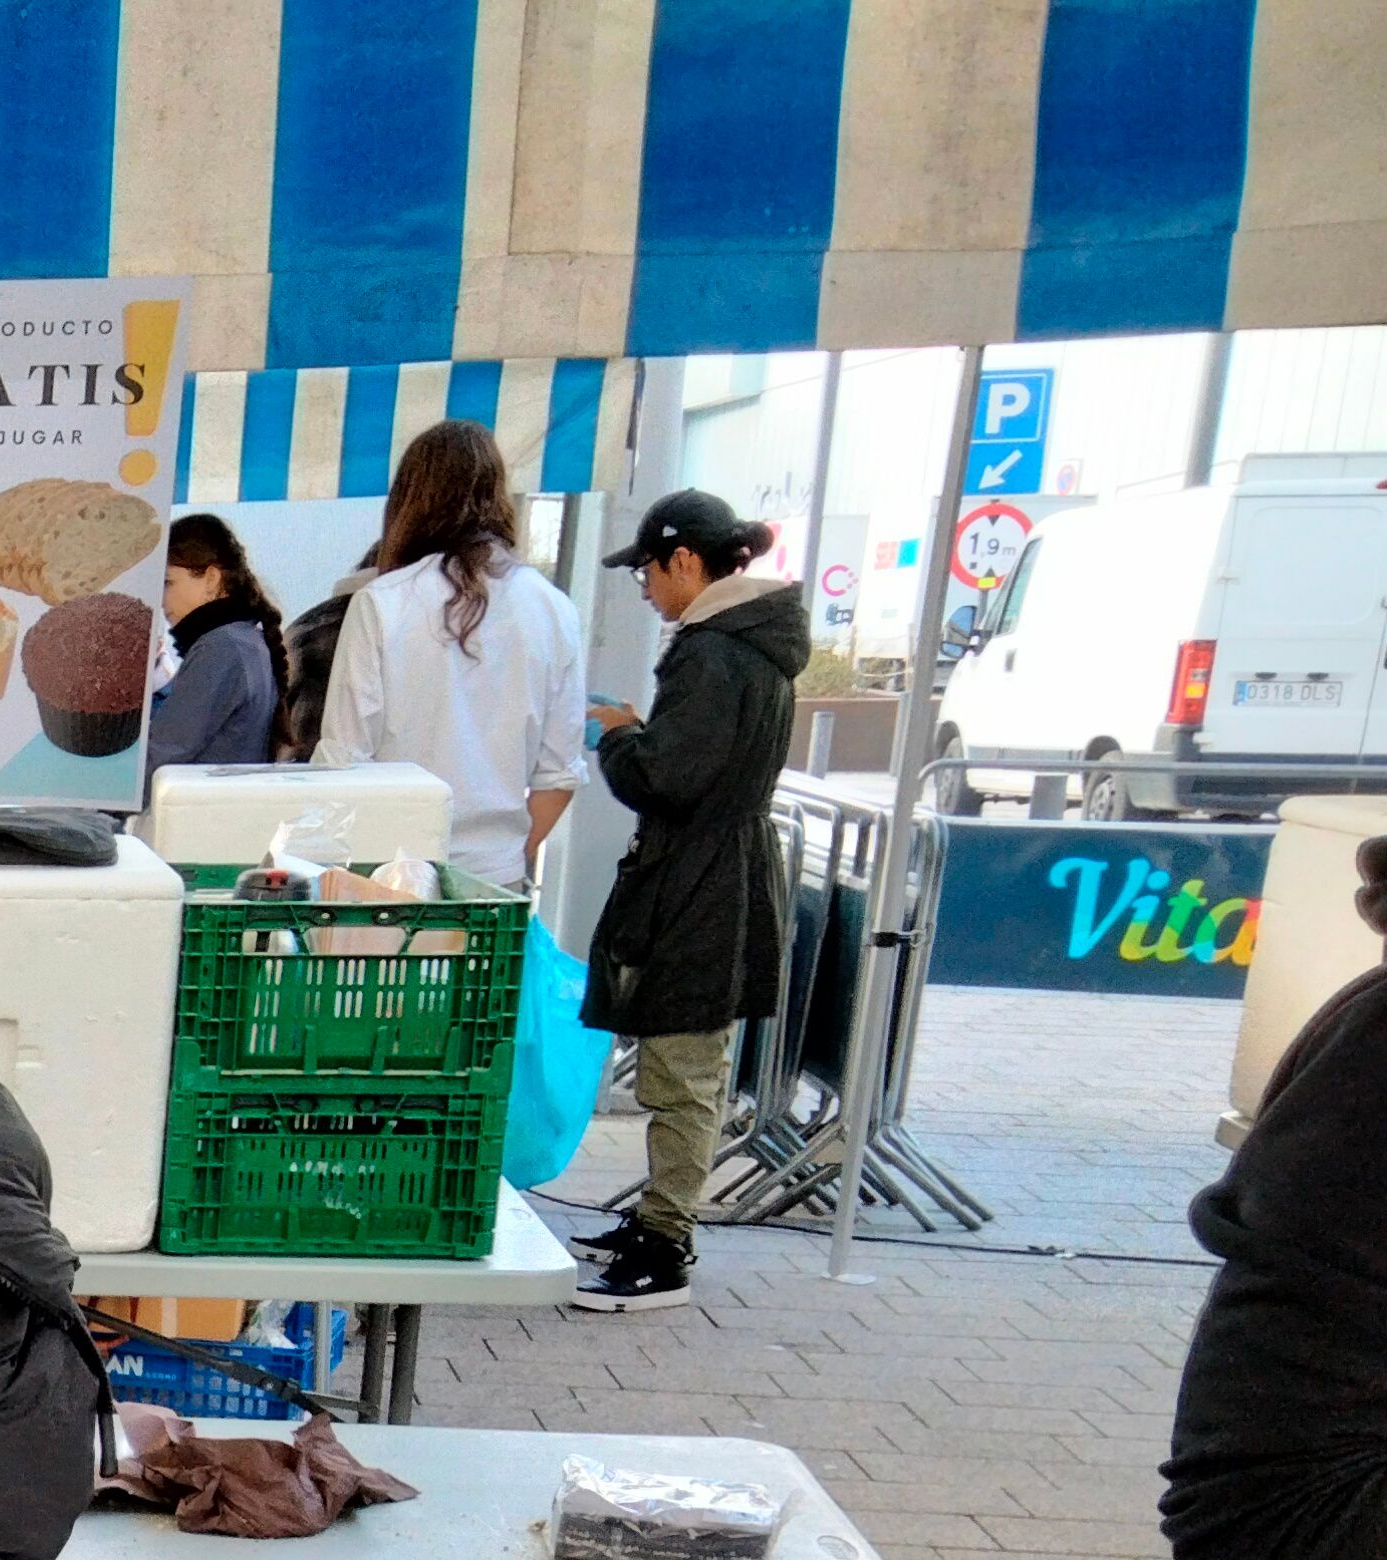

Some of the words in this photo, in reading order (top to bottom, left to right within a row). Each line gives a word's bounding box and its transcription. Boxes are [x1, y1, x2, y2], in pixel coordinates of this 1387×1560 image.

[984, 382, 1031, 434] P
[1247, 684, 1293, 700] 0318
[1300, 684, 1336, 701] DLS
